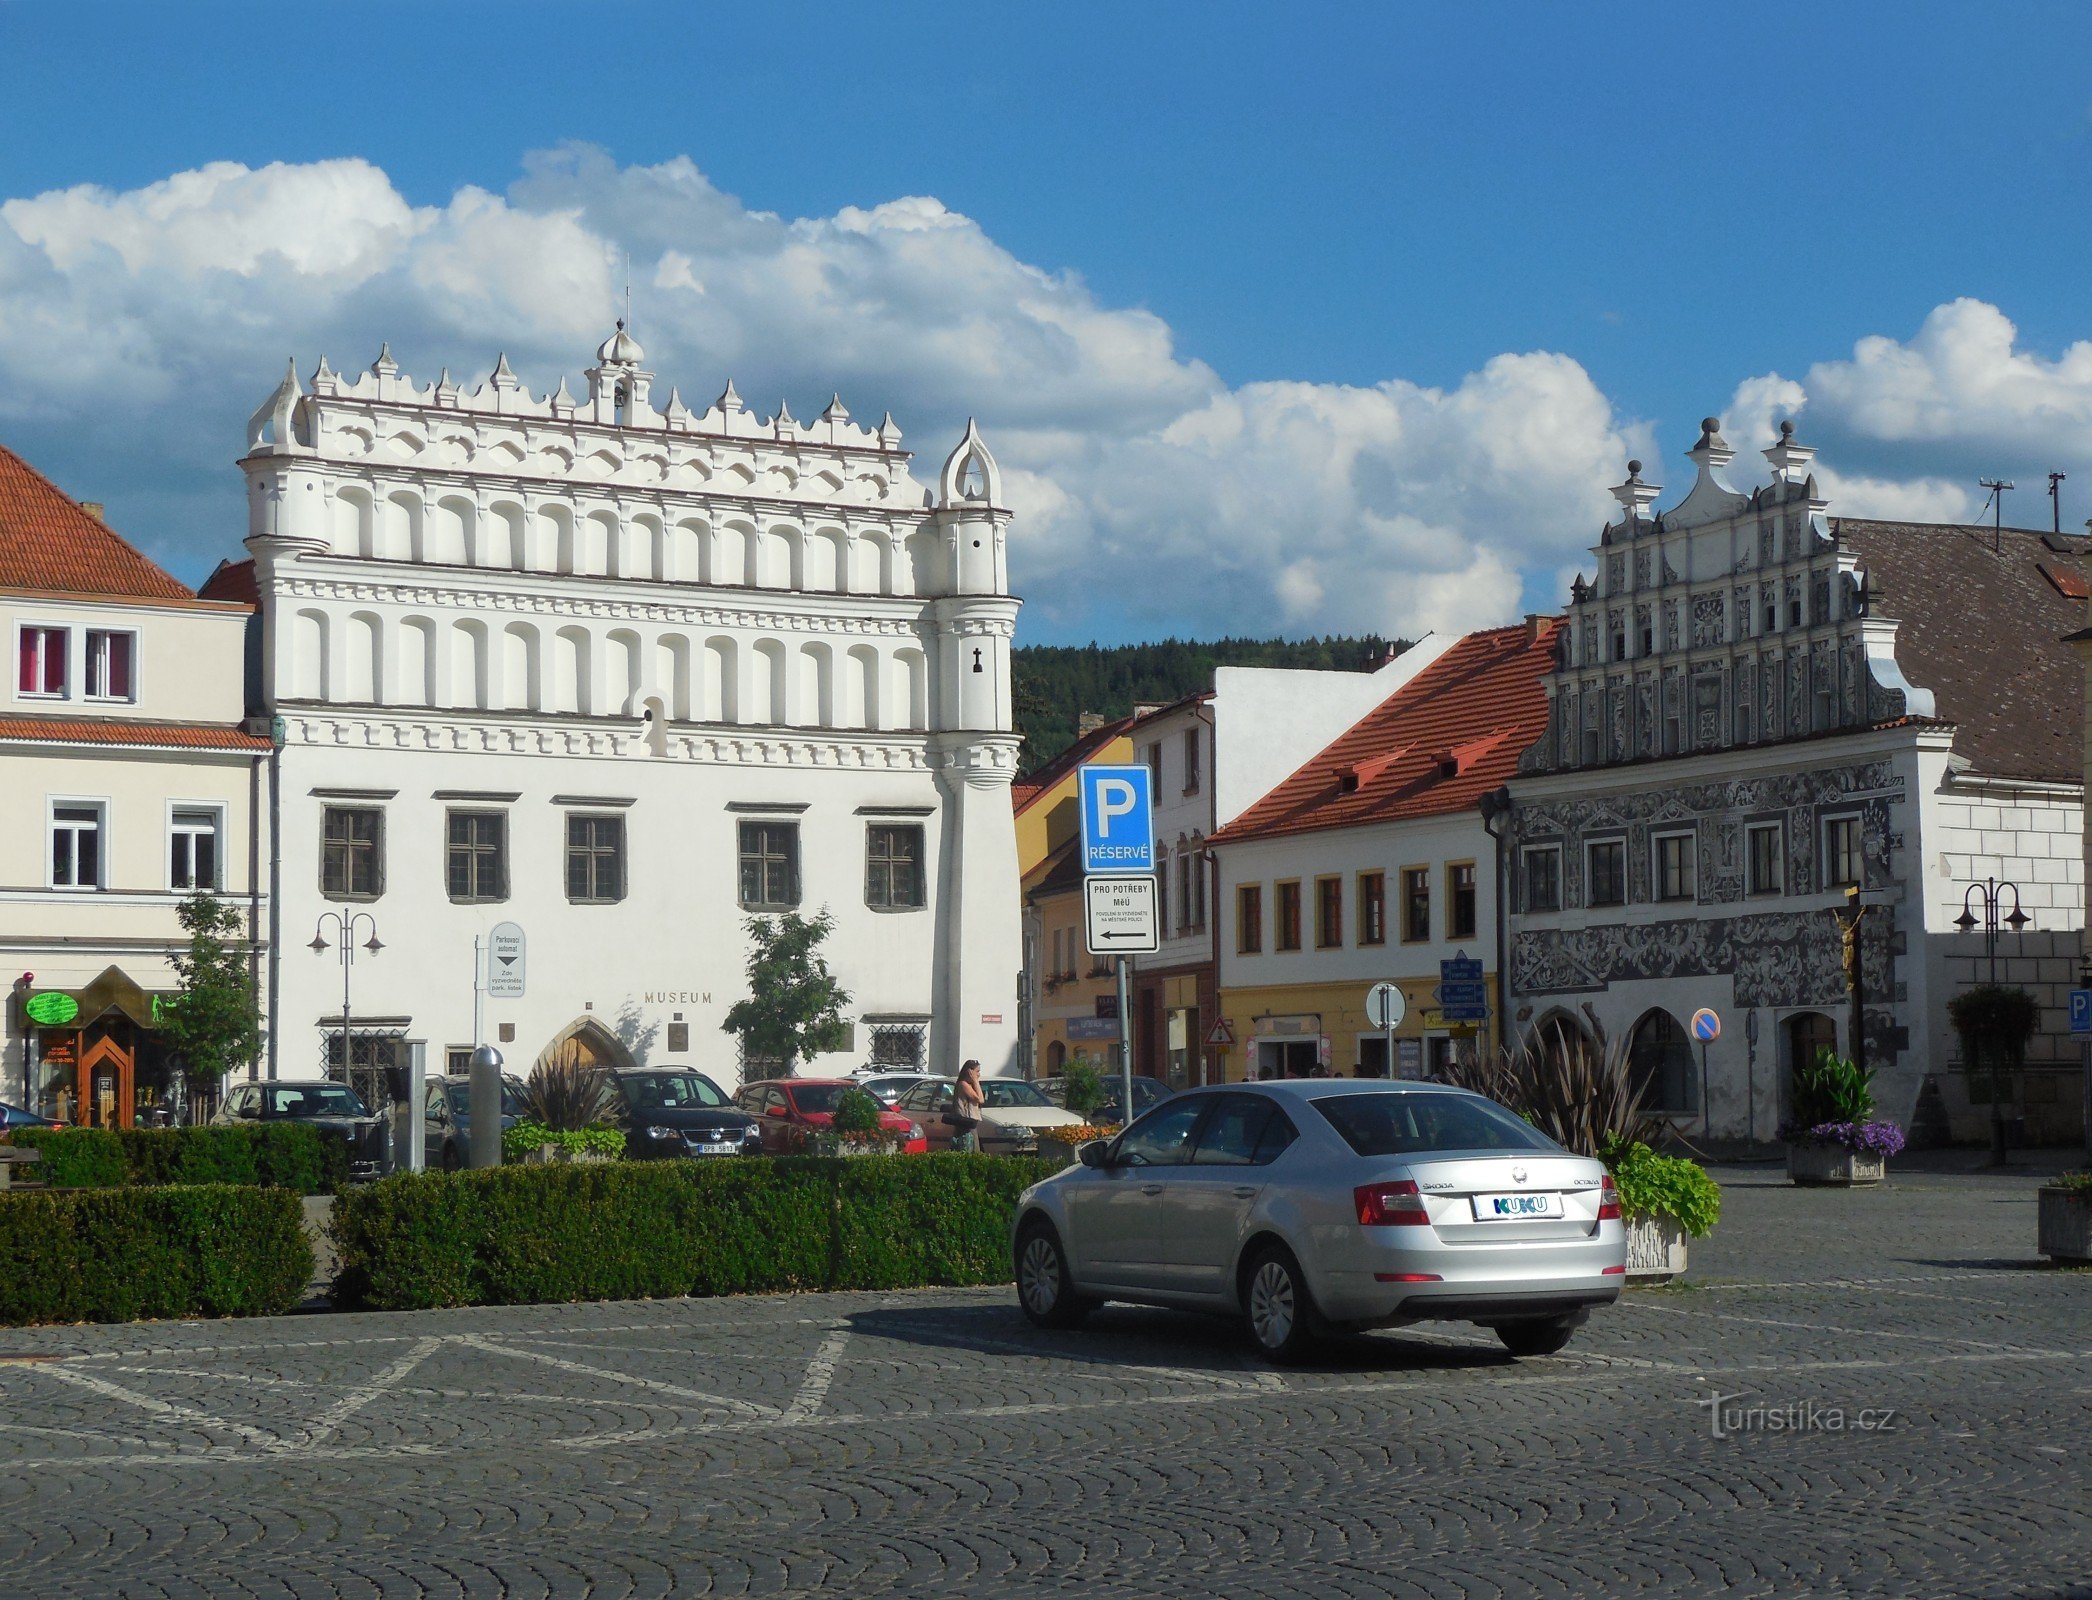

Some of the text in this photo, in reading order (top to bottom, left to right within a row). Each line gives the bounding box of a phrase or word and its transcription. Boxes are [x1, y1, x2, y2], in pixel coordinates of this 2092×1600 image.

[1095, 778, 1136, 838] P
[1090, 843, 1149, 860] RÉSERVÉ
[1094, 883, 1148, 894] PRO POTŘEBY
[1113, 896, 1130, 907] MěÚ
[644, 991, 713, 1004] MUSEUM
[2073, 995, 2087, 1019] P
[1422, 1182, 1455, 1191] ŠKODA
[1493, 1195, 1548, 1215] KUKU
